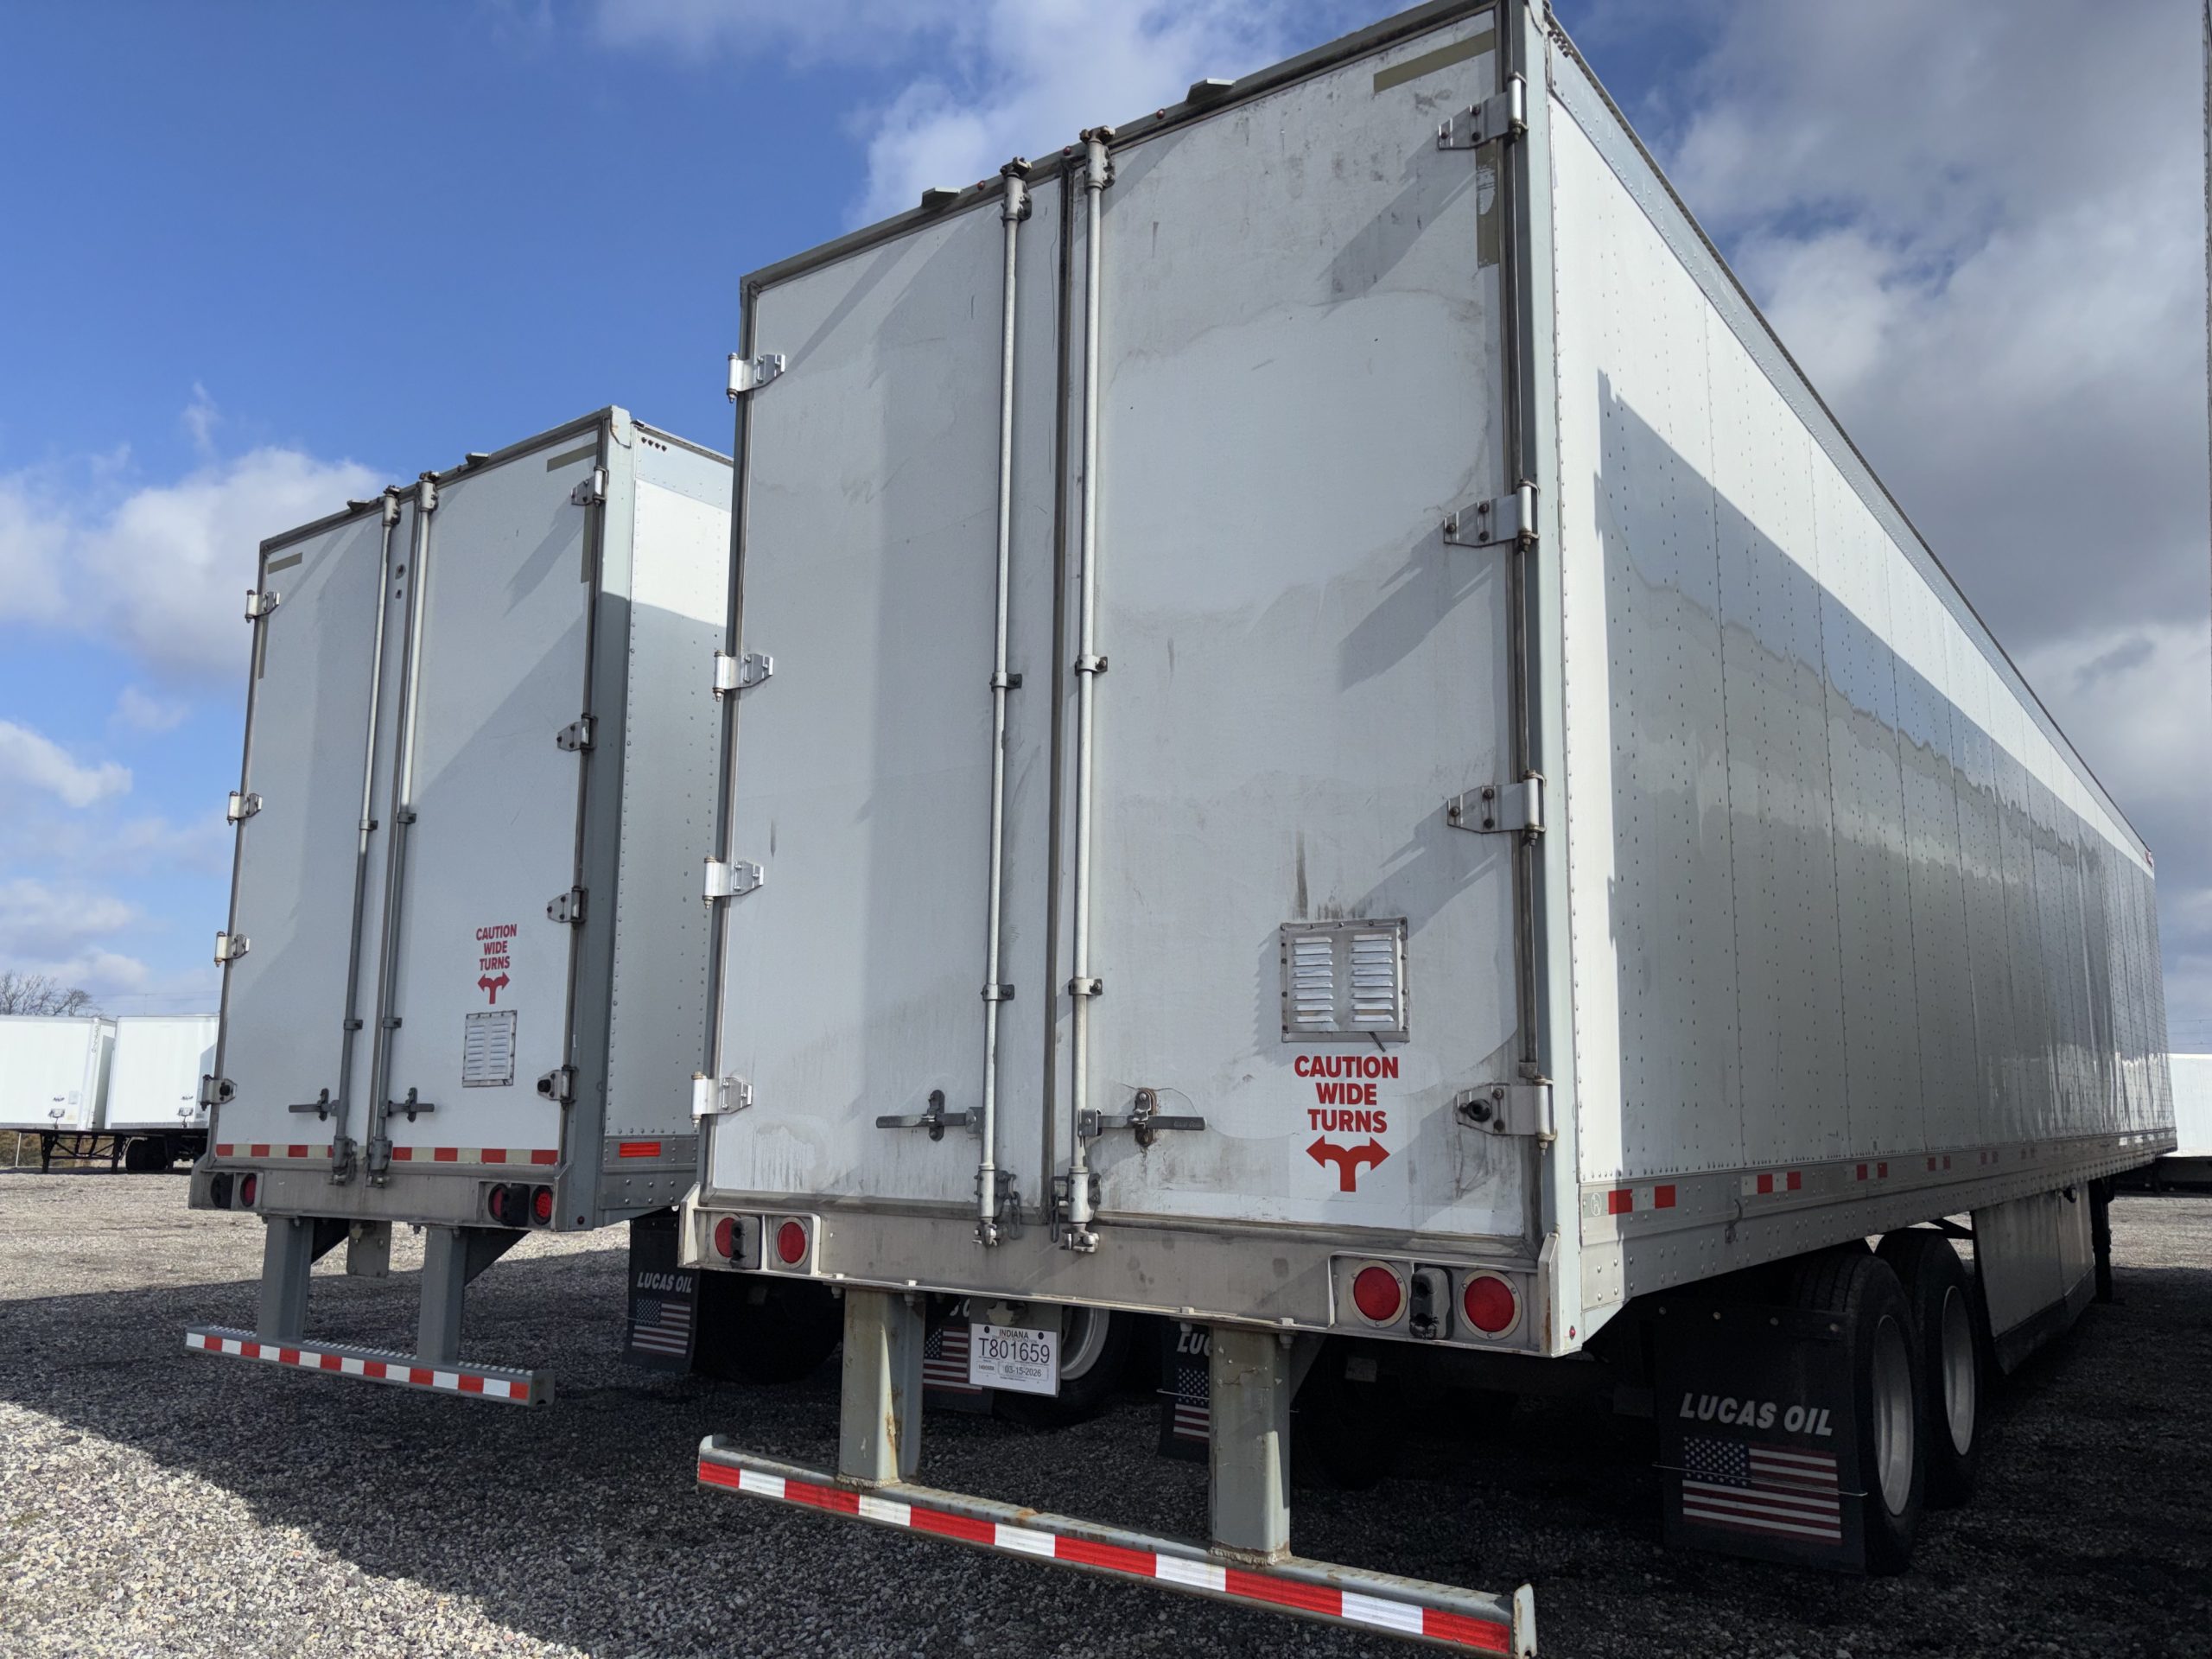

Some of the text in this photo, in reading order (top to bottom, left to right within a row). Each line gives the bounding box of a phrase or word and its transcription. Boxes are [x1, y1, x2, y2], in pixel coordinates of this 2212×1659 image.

[476, 924, 518, 941] CAUTION
[484, 940, 508, 956] WIDE
[479, 956, 511, 971] TURNS
[1294, 1055, 1399, 1078] CAUTION
[1315, 1083, 1377, 1105] WIDE
[1307, 1109, 1388, 1134] TURNS
[637, 1272, 692, 1293] LUCAS OIL
[999, 1328, 1029, 1339] INDIANA
[978, 1337, 1050, 1363] T801659
[1004, 1365, 1042, 1377] 03-15-2026
[1680, 1393, 1833, 1436] LUCAS OIL
